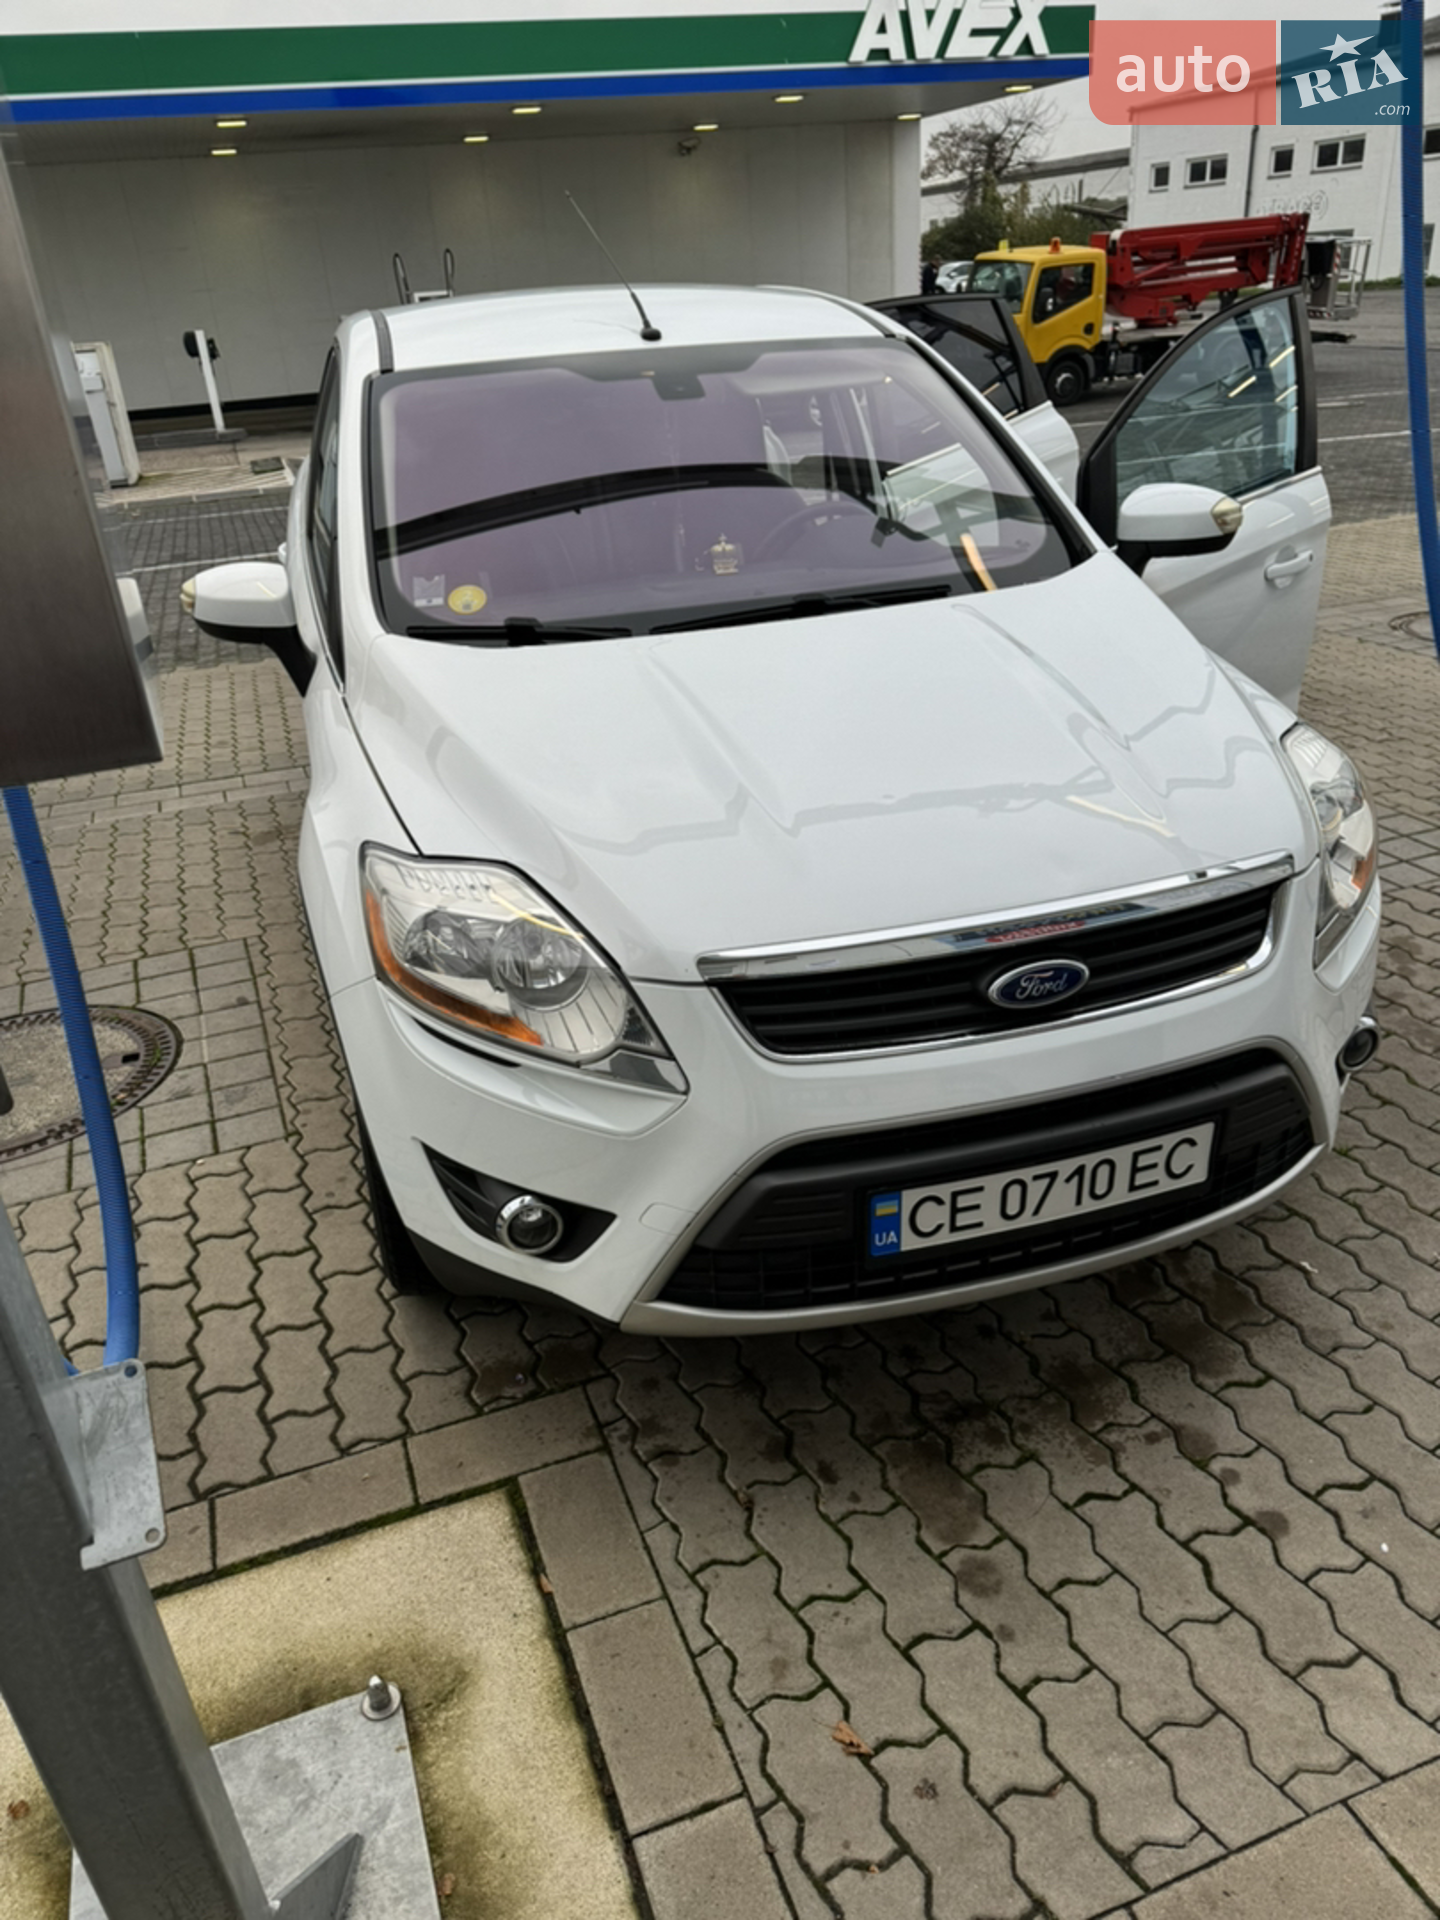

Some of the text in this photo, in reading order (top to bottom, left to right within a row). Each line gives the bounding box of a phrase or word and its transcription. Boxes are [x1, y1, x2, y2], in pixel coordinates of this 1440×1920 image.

[848, 0, 1051, 63] AVEX
[1014, 970, 1068, 999] Ford
[908, 1136, 1198, 1239] CE 0710 EC
[874, 1230, 898, 1246] UA
